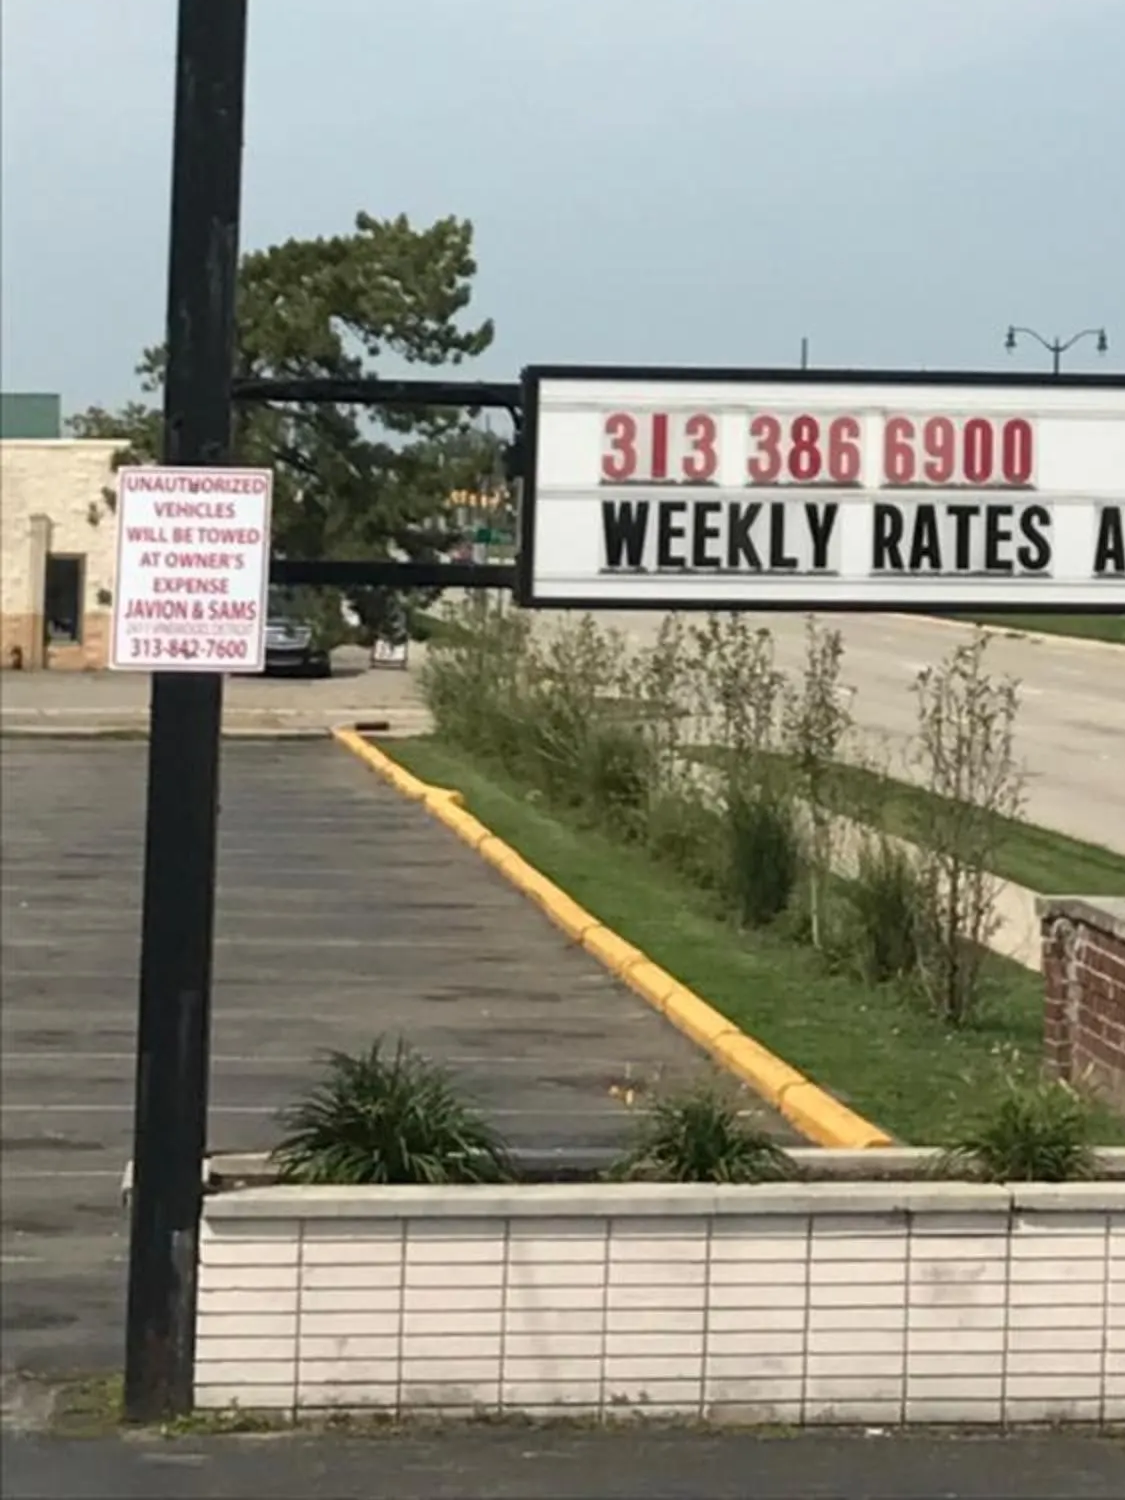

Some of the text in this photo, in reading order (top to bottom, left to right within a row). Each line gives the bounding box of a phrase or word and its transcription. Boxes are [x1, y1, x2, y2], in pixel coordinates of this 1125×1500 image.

[601, 412, 718, 482] 313
[746, 414, 863, 483] 386
[884, 415, 1034, 485] 6900
[127, 476, 266, 494] UNAUTHORIZED
[153, 501, 236, 519] VEHICLES
[127, 527, 261, 545] WILL BE TOWED
[602, 500, 839, 571] WEEKLY
[872, 503, 1052, 572] RATES
[139, 552, 246, 570] AT OWNER'S
[152, 577, 230, 594] EXPENSE
[192, 600, 204, 619] &
[208, 601, 257, 621] SAMS
